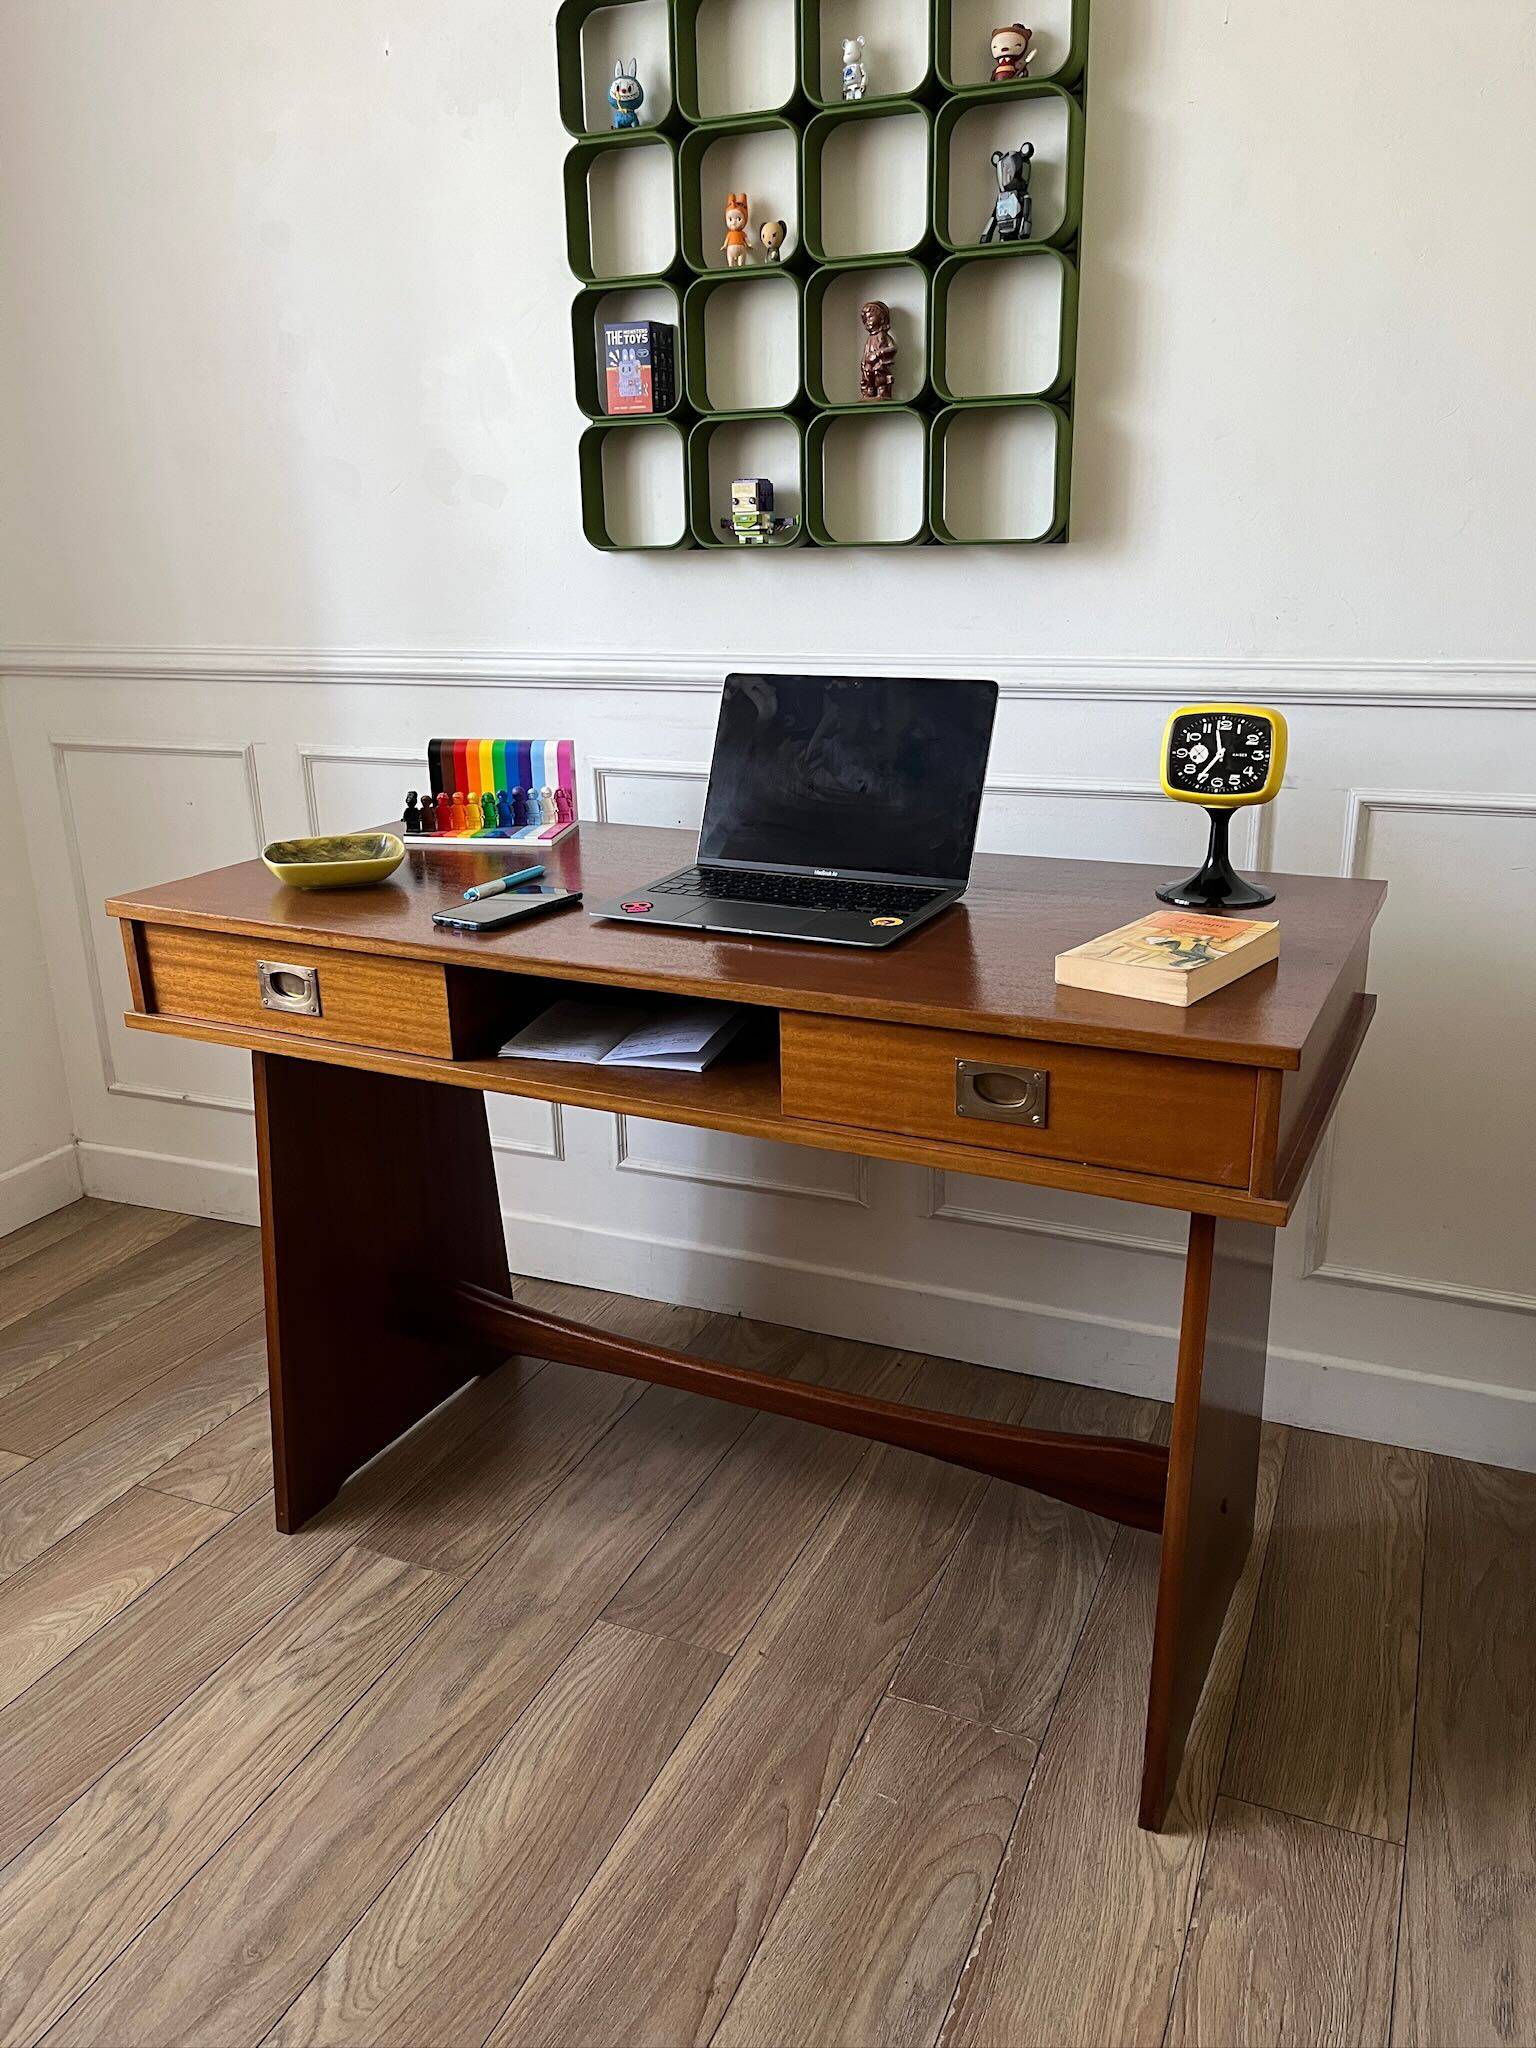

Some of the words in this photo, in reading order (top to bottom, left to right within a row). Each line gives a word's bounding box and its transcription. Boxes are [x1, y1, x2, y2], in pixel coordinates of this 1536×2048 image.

[605, 330, 623, 345] THE
[623, 333, 649, 345] TOYS
[1202, 722, 1212, 734] 11
[1236, 723, 1241, 735] 1
[1186, 732, 1202, 743] 10
[1245, 734, 1260, 746] 2
[1176, 747, 1189, 758] 9
[1251, 750, 1264, 761] 3
[1183, 763, 1197, 774] 8
[1242, 765, 1254, 777] 4
[1197, 772, 1209, 784] 7
[1210, 777, 1224, 788] 6
[1228, 774, 1241, 786] 5
